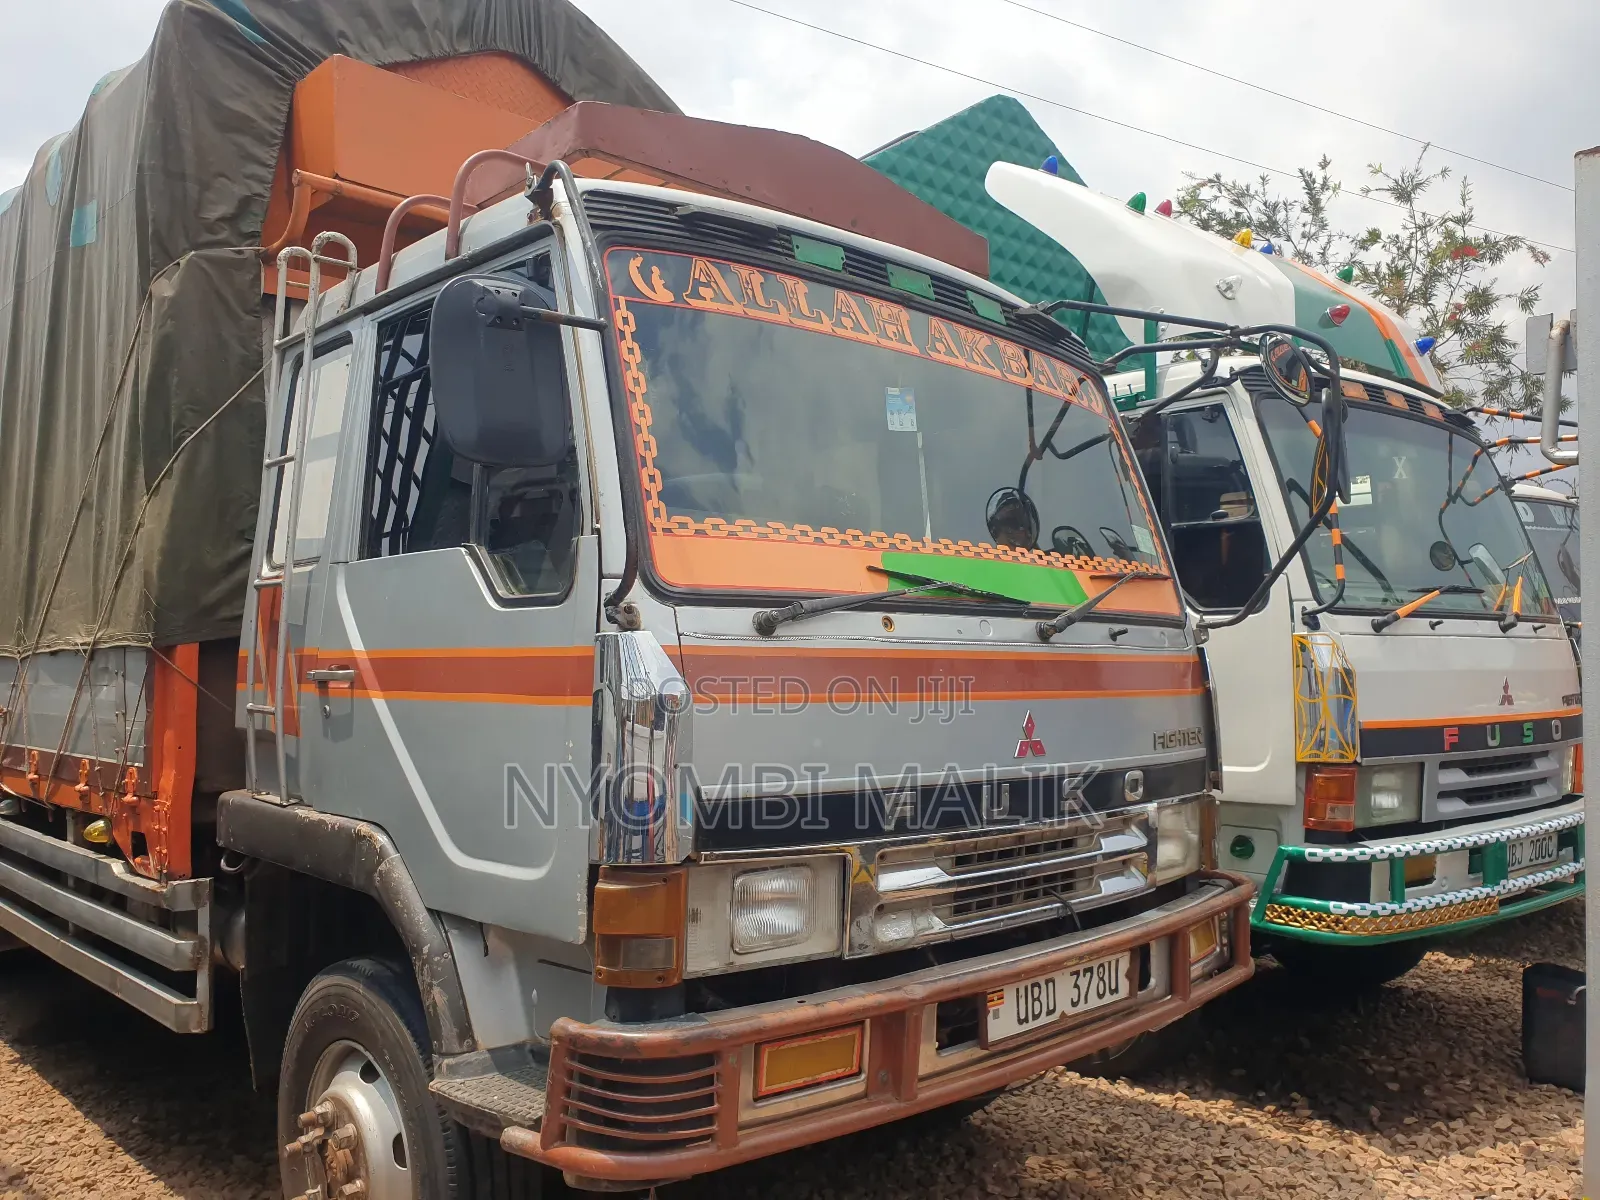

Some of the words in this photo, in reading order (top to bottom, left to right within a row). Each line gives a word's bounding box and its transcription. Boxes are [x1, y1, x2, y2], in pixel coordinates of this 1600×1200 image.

[682, 257, 919, 355] ALLAH
[1443, 719, 1562, 751] FUSO
[884, 769, 1144, 832] FUSO
[1015, 976, 1057, 1026] UBD
[1070, 957, 1120, 1009] 378U
